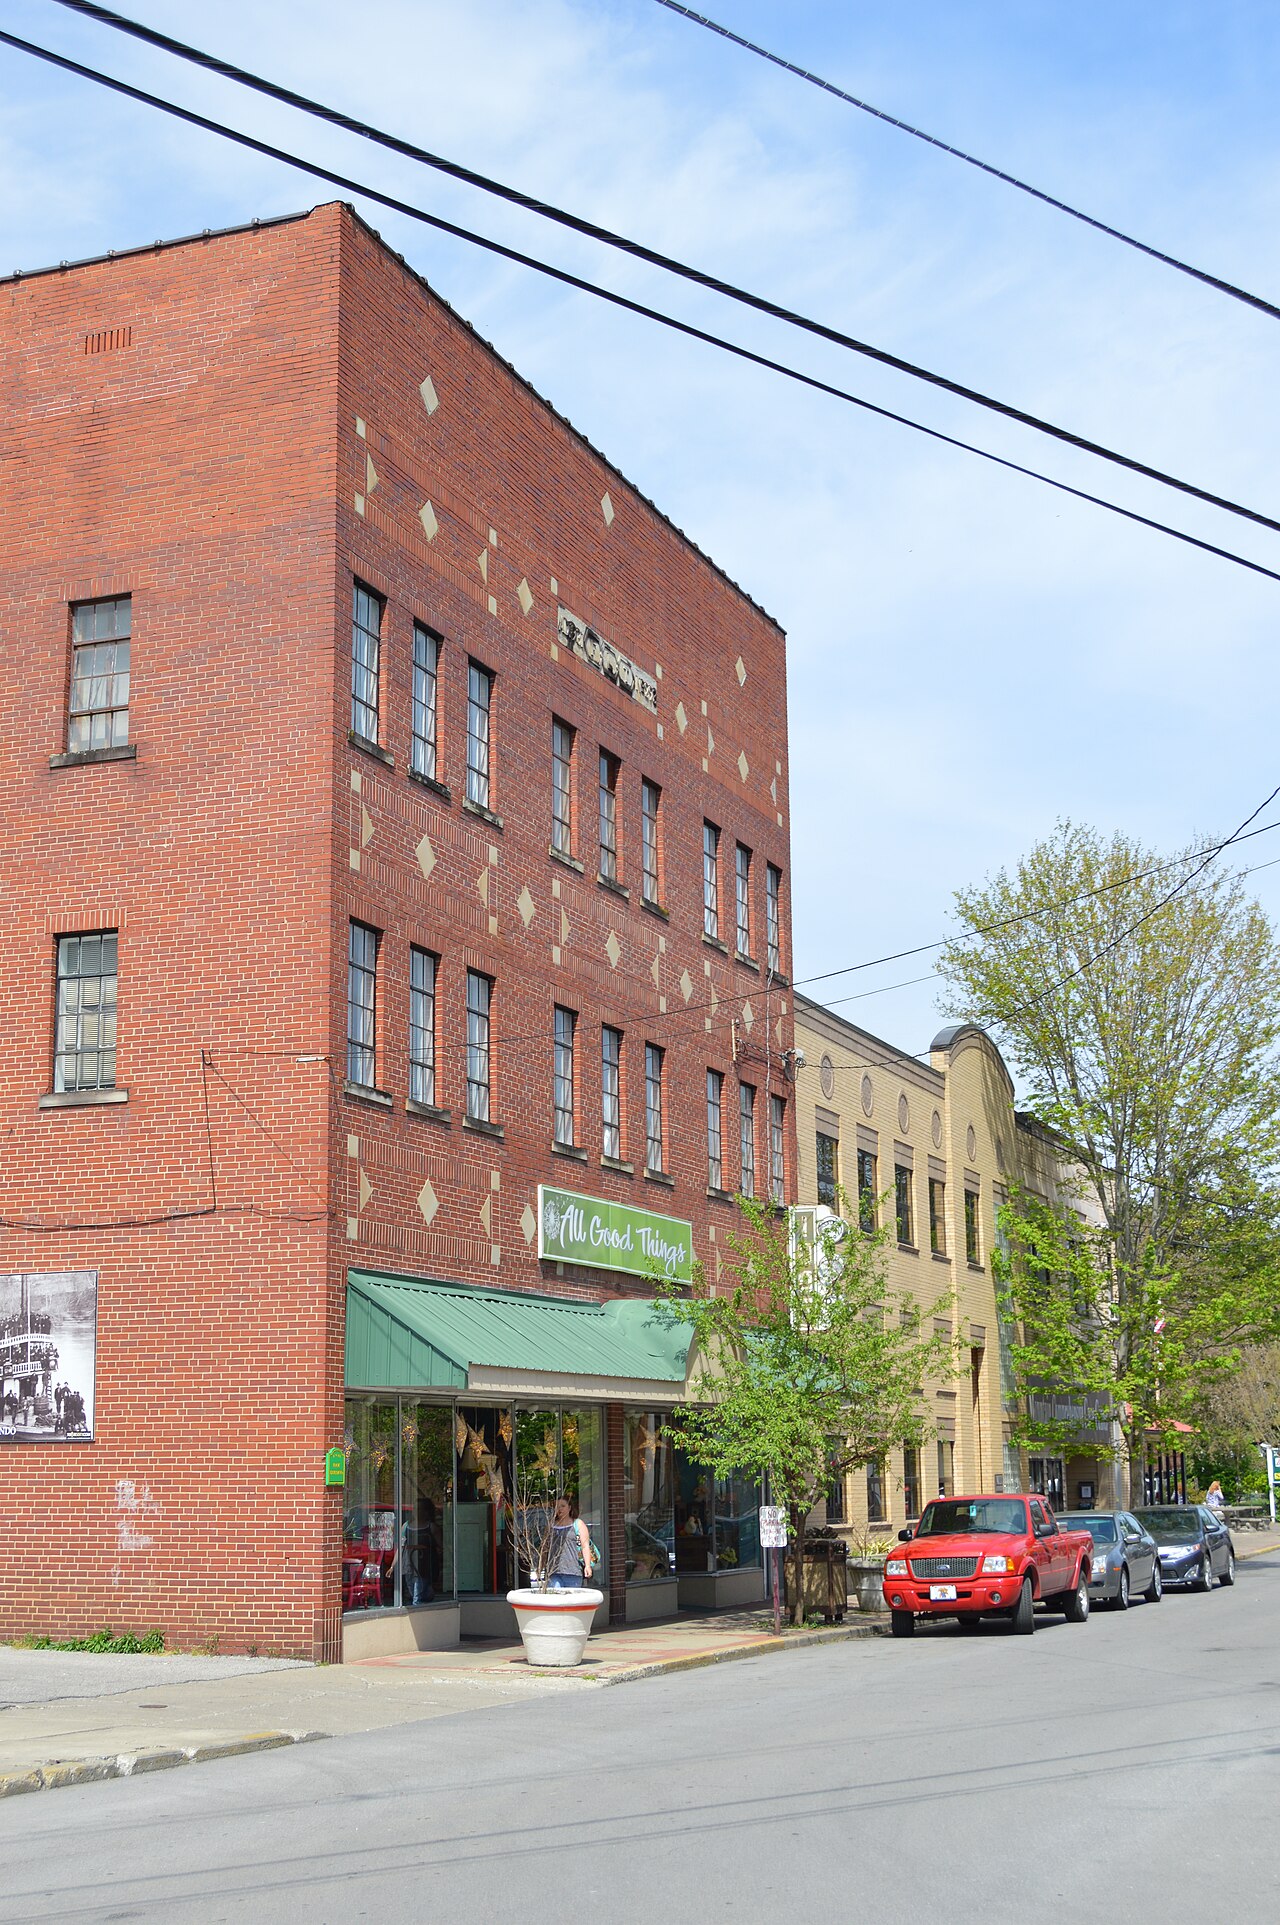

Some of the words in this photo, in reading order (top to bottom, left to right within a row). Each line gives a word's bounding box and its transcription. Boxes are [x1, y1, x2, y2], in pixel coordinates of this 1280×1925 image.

[559, 1204, 587, 1249] All
[589, 1215, 634, 1252] Good
[635, 1226, 687, 1276] Things
